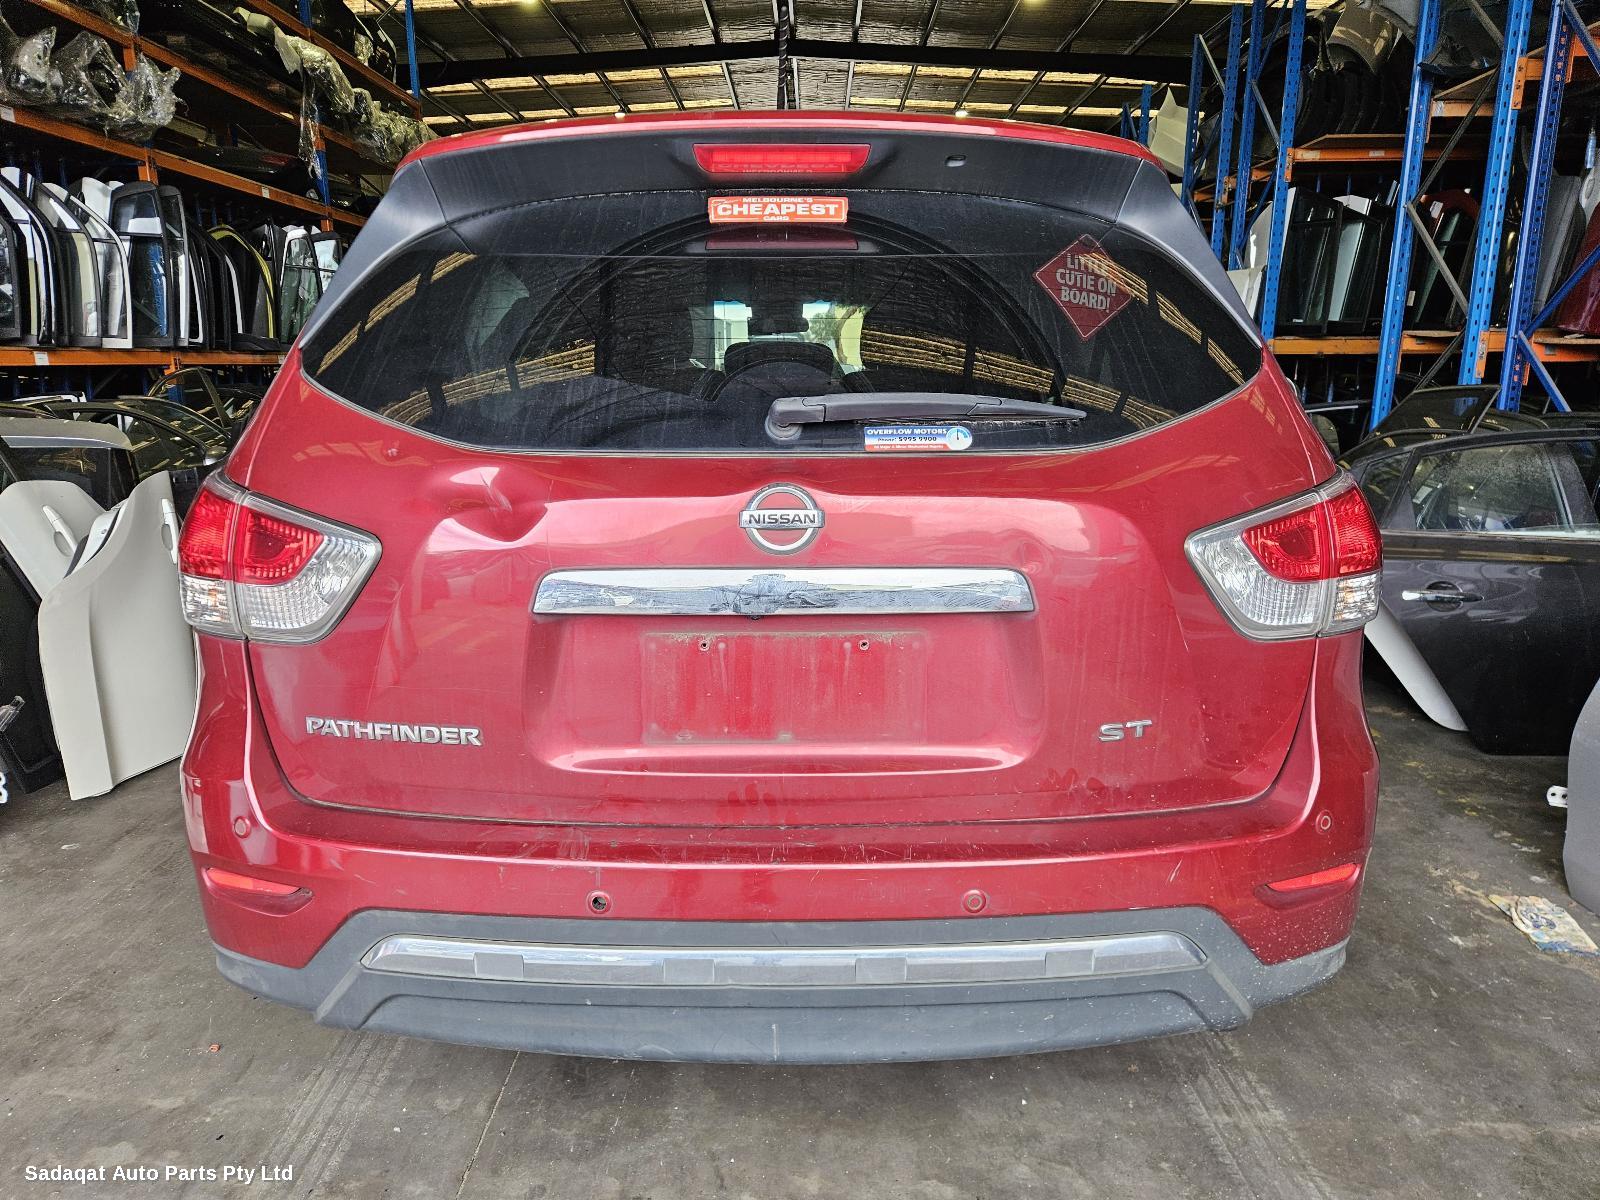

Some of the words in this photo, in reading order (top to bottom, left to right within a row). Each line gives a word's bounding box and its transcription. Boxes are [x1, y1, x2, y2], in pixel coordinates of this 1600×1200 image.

[717, 203, 839, 216] CHEAPEST
[1055, 268, 1095, 291] CUTIE
[1097, 277, 1117, 296] ON
[1060, 286, 1111, 313] BOARD!
[748, 513, 816, 524] NISSAN
[305, 716, 482, 746] PATHFINDER
[1099, 719, 1153, 742] ST
